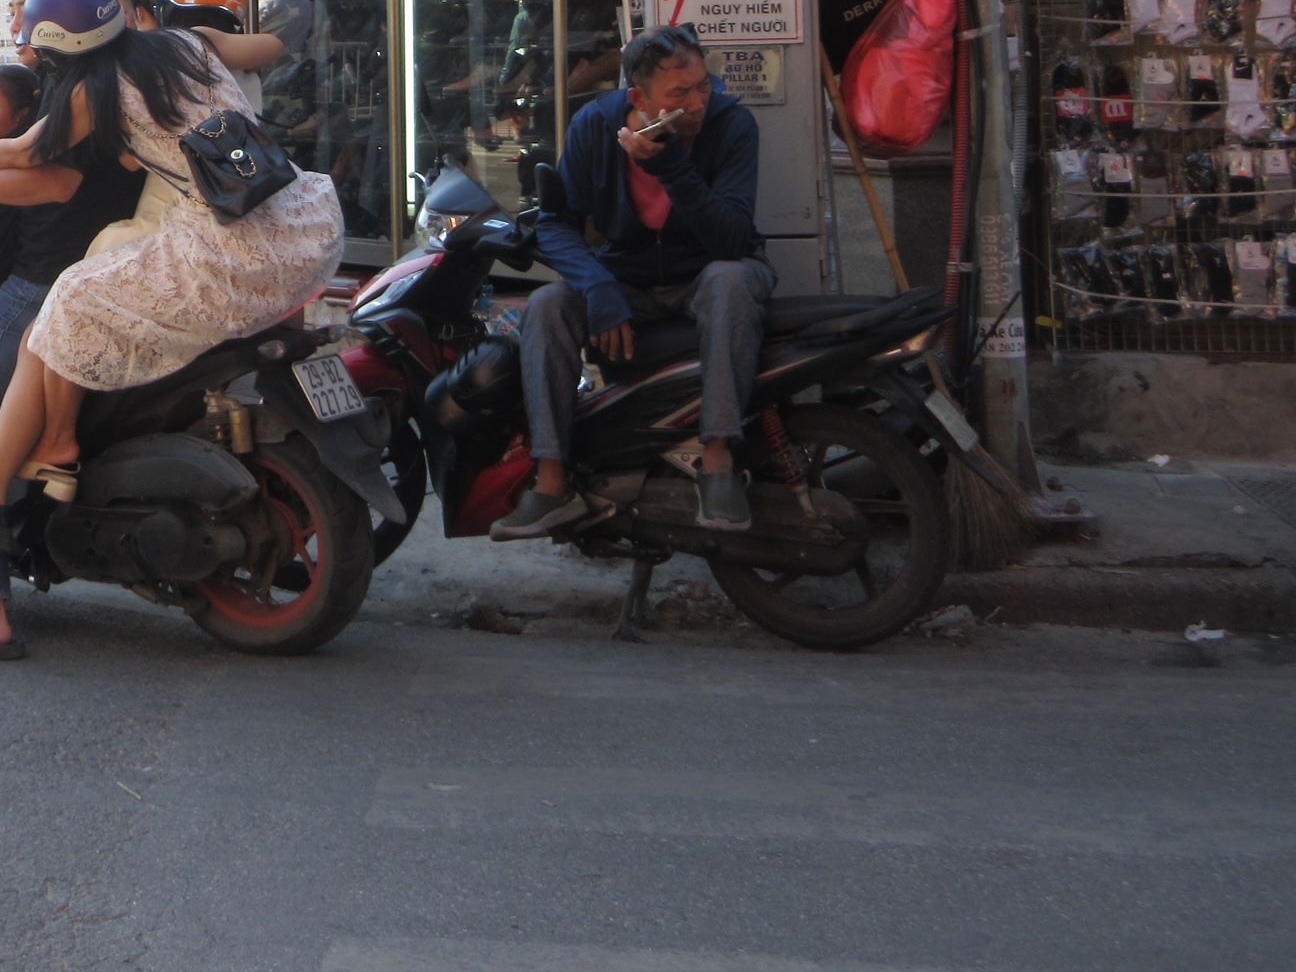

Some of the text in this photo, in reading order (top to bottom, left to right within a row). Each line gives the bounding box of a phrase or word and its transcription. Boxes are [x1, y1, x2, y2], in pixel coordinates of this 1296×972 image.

[701, 4, 741, 16] NGUY
[697, 18, 787, 34] CHẾT NGƯỜI
[722, 51, 764, 61] TBA
[722, 74, 758, 82] PILLAR
[312, 384, 361, 418] 227.29
